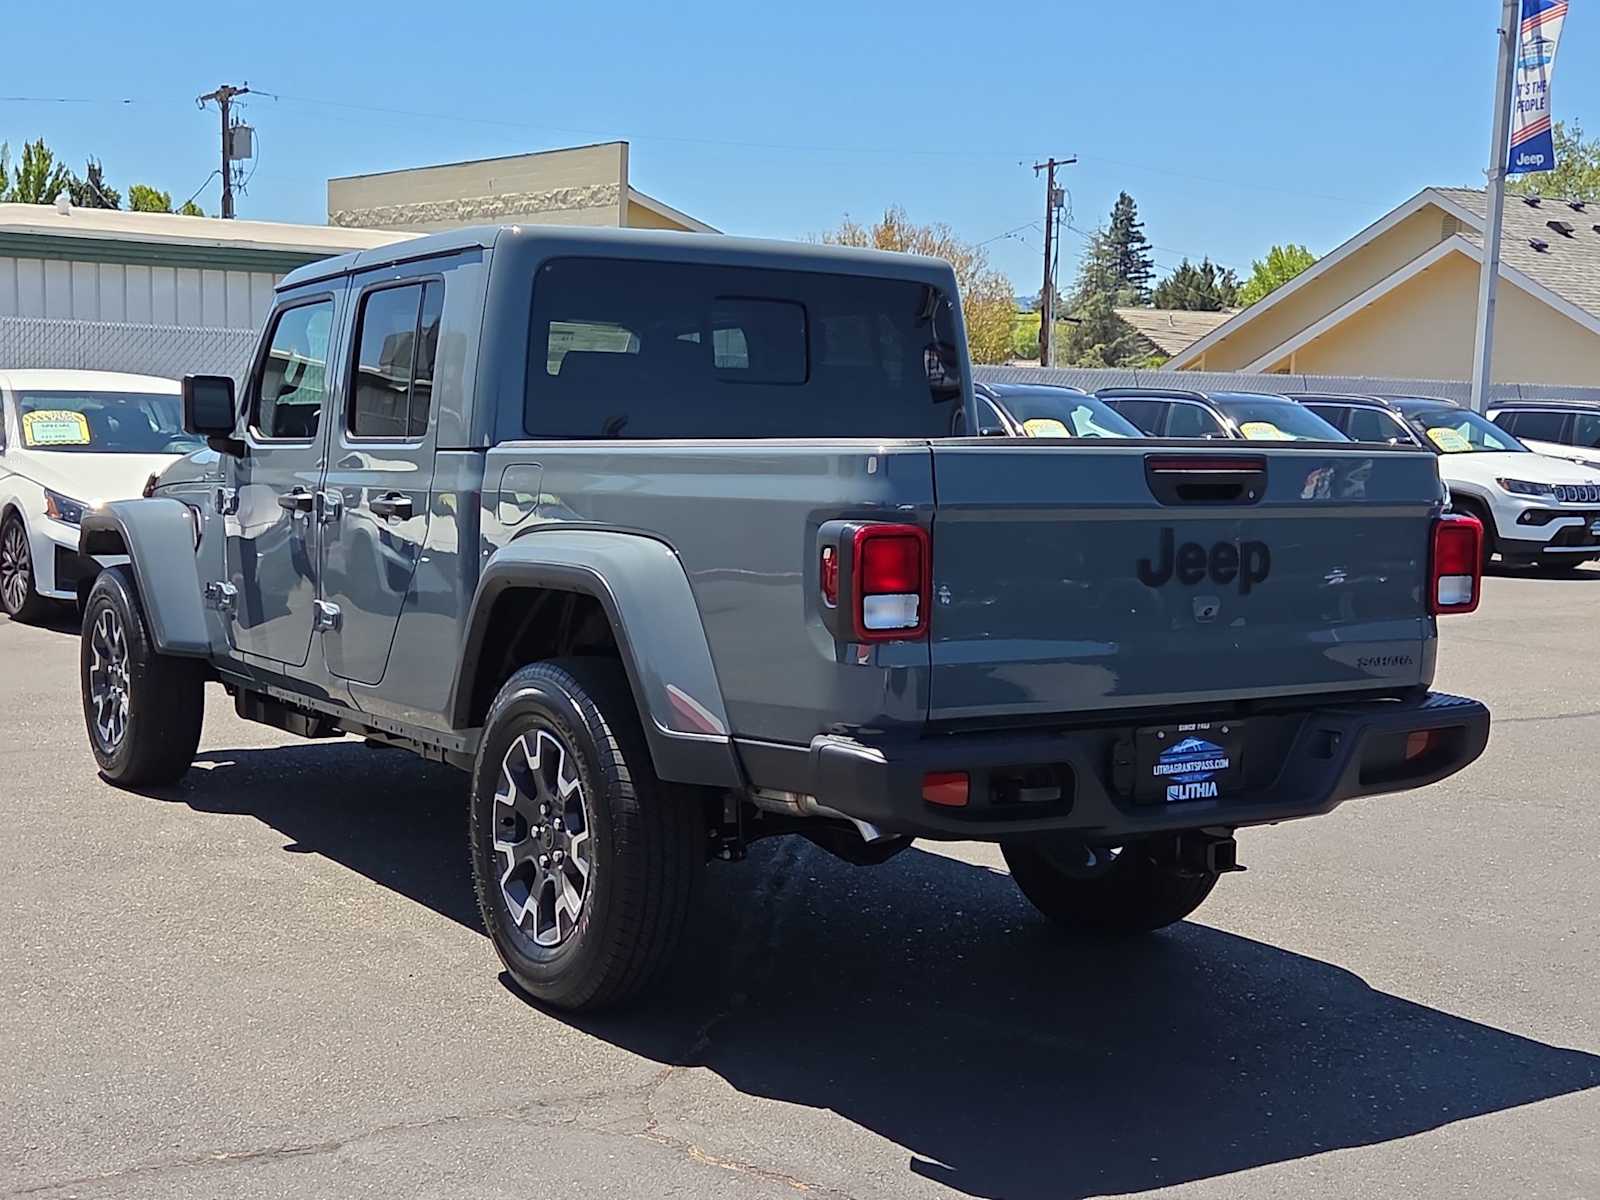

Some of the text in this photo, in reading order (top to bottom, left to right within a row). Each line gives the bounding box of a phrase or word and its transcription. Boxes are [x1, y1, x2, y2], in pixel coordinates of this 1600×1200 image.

[1532, 80, 1546, 93] THE
[1517, 98, 1544, 112] PEOPLE
[1517, 153, 1544, 166] Jeep
[1137, 527, 1271, 594] Jeep
[1153, 758, 1229, 775] LITHIAGRANTSPASS.COM
[1179, 782, 1218, 800] LITHIA
